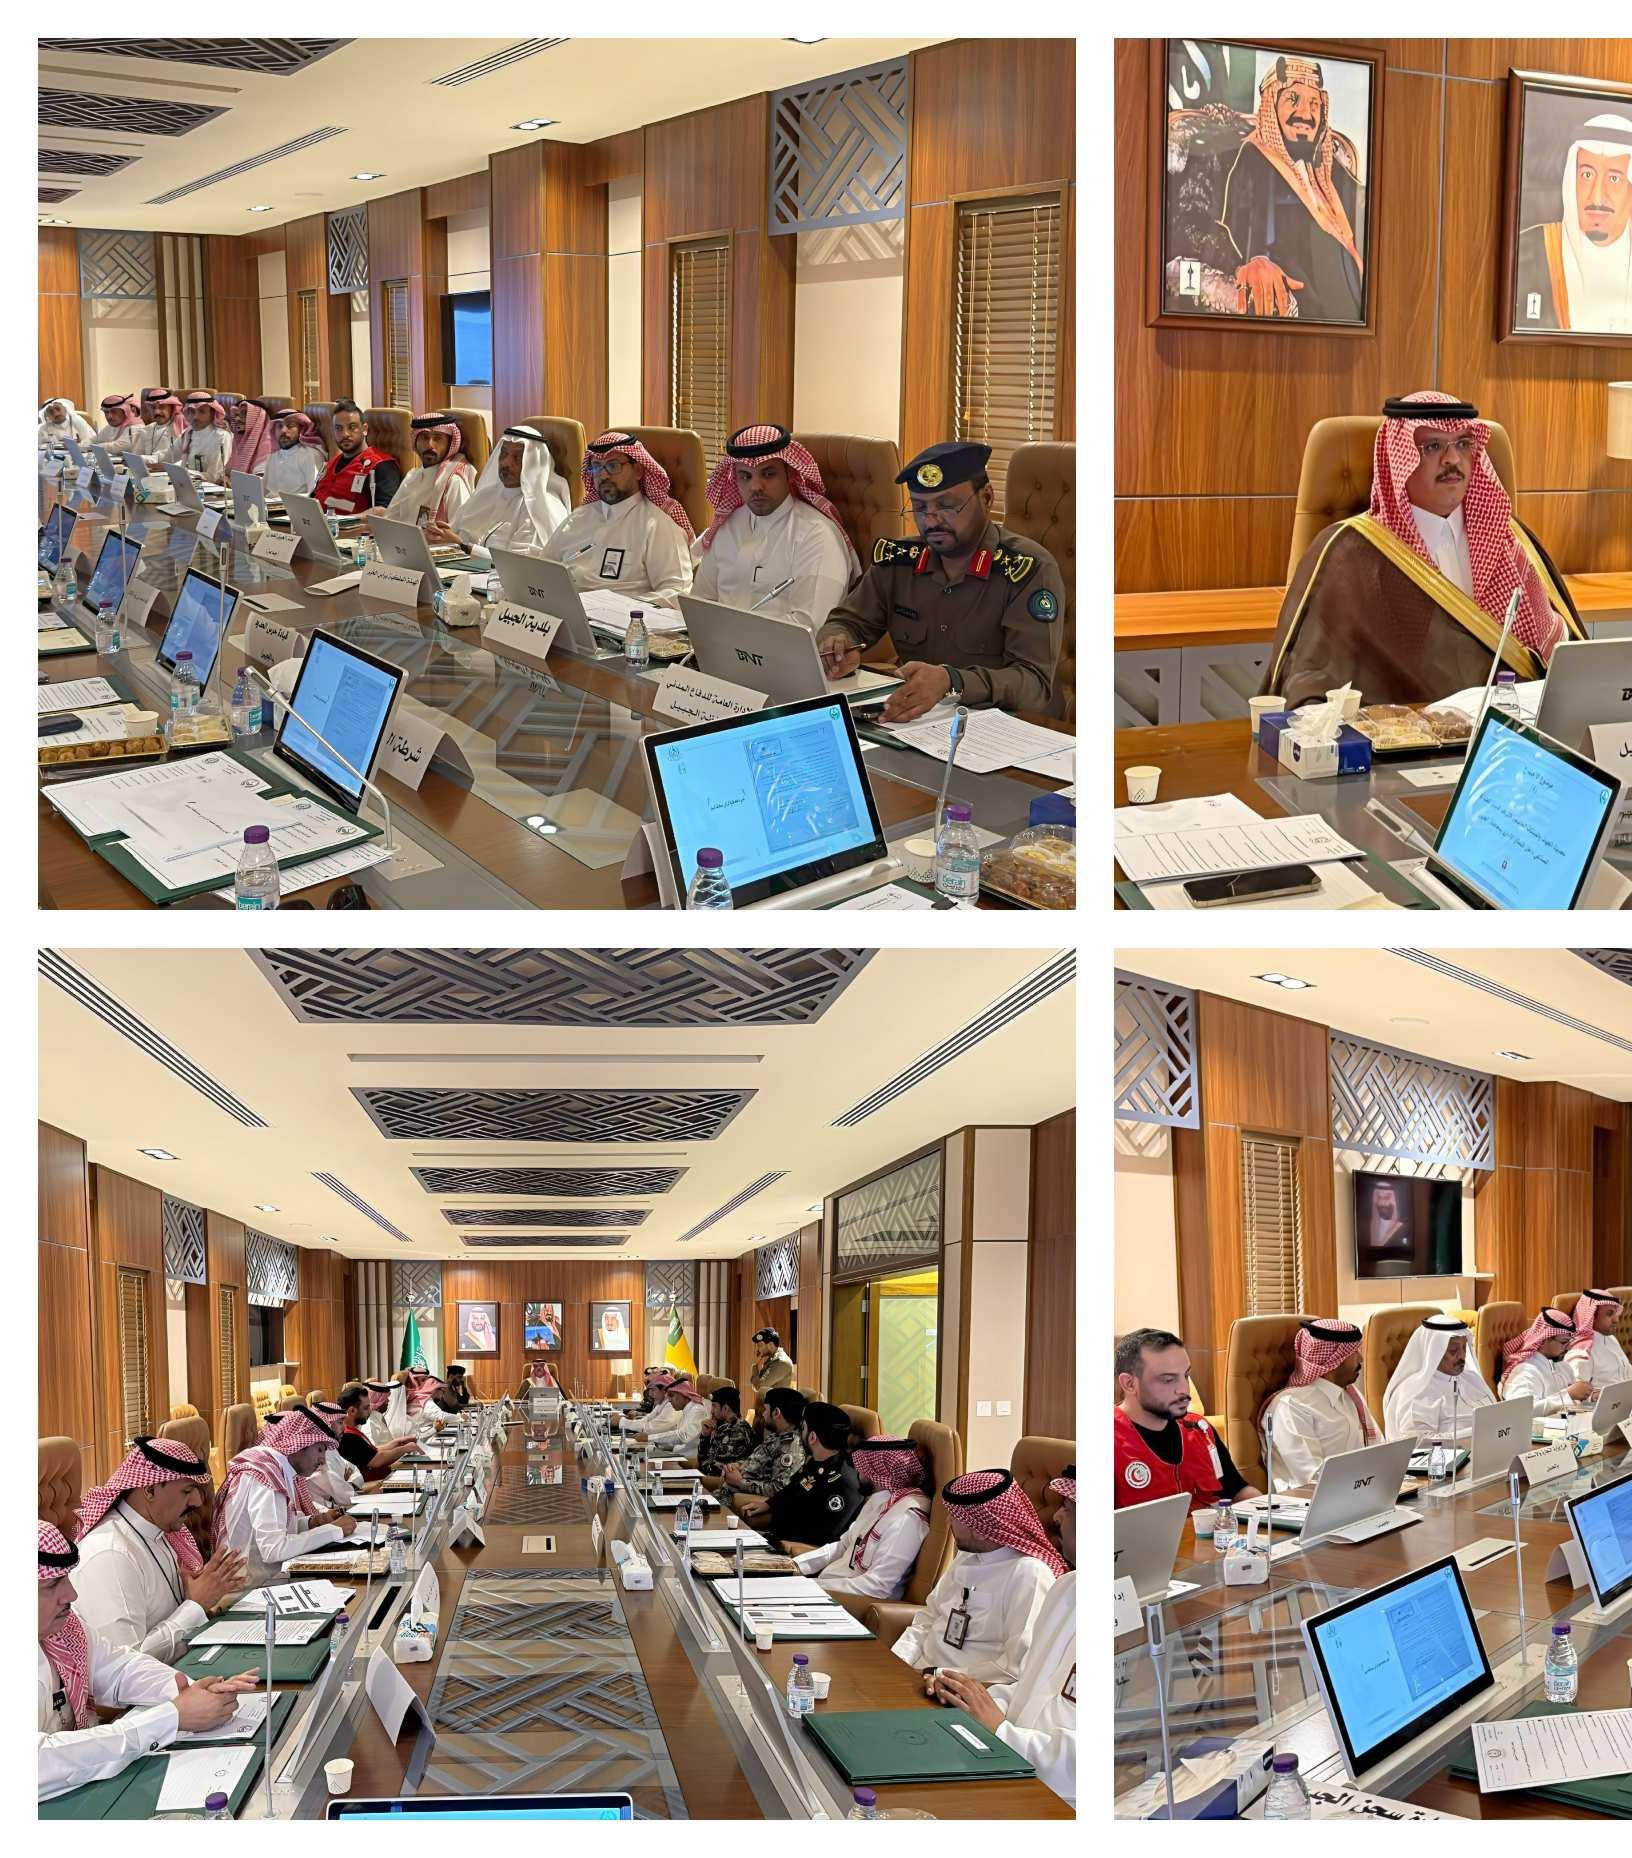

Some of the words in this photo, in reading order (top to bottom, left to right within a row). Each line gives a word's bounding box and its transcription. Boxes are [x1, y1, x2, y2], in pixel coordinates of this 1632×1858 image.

[498, 607, 527, 627] الجبيل
[524, 614, 551, 637] بلدية
[392, 736, 422, 763] شرطة
[1309, 1791, 1354, 1806] الجب
